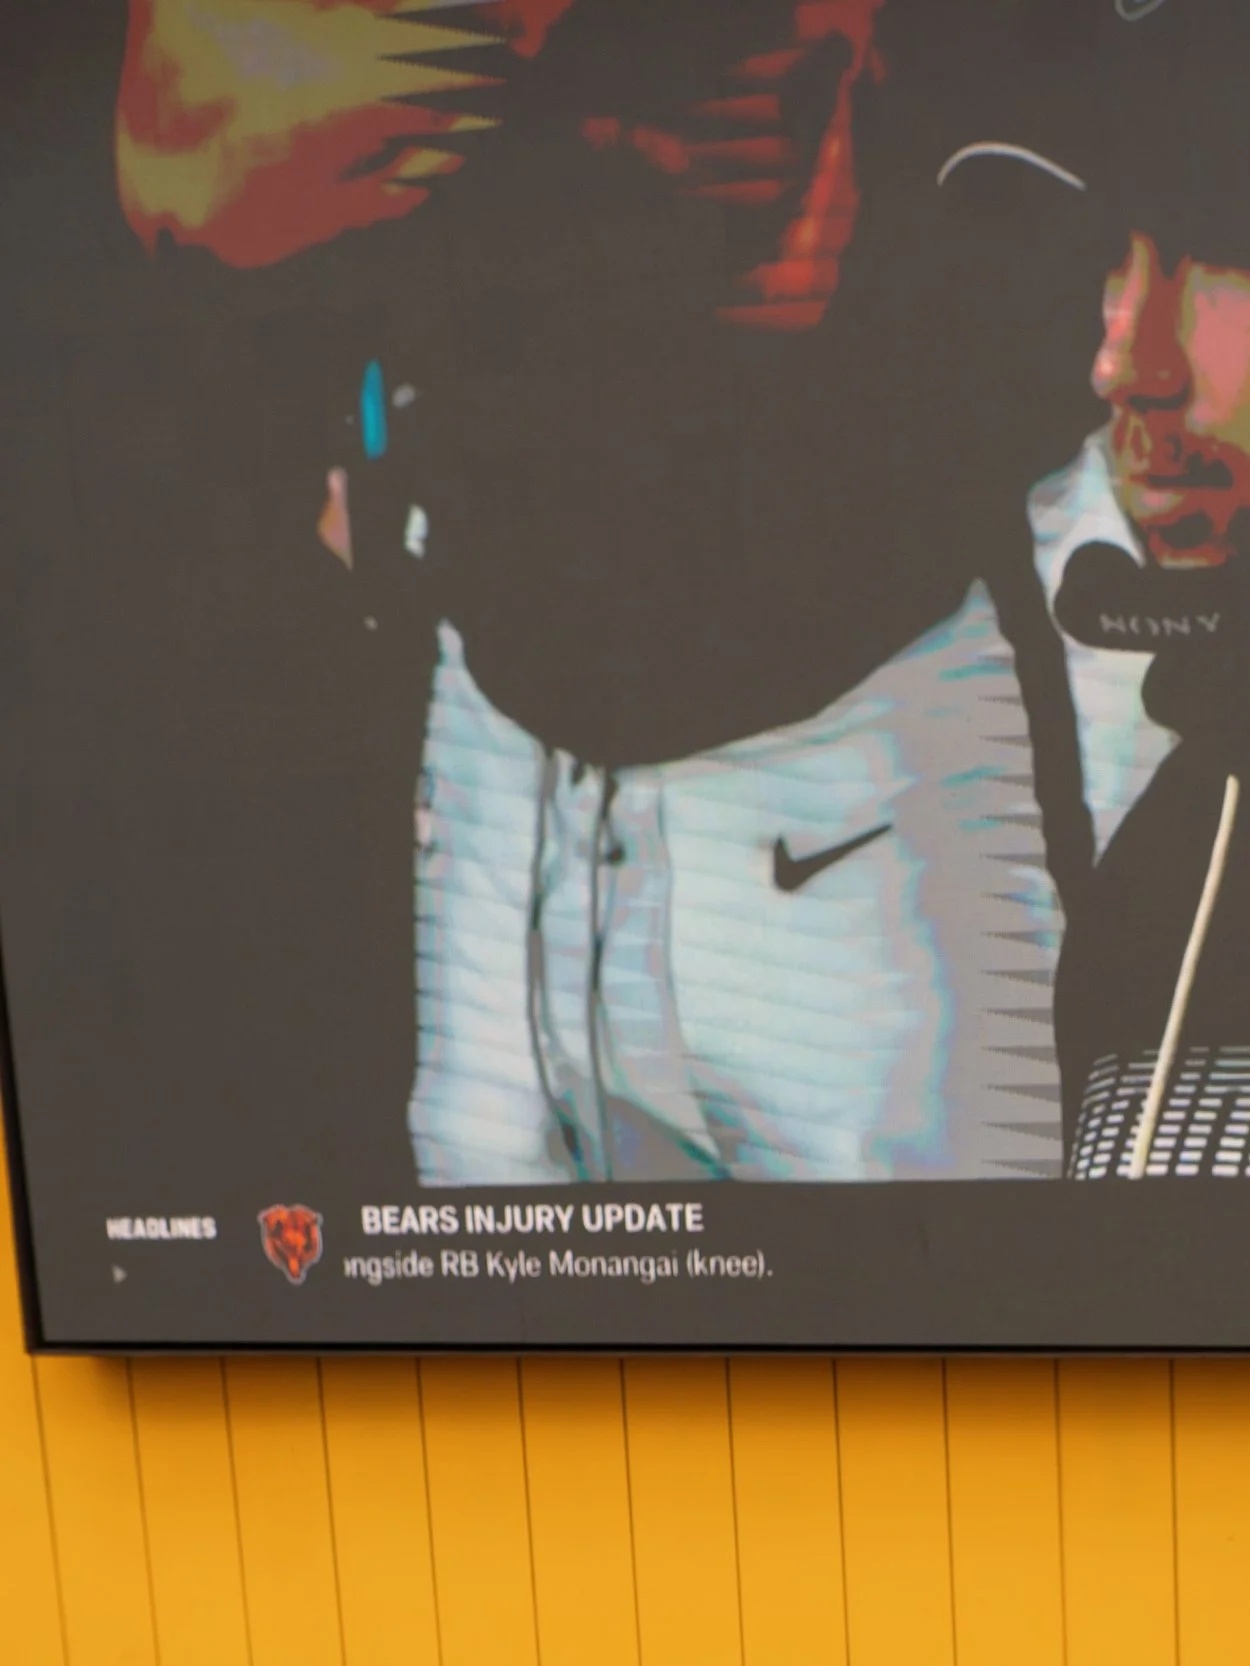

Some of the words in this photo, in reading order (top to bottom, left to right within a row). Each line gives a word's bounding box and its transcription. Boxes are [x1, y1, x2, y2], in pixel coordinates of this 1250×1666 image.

[105, 1215, 218, 1241] HEADLINES
[361, 1204, 459, 1235] BEARS
[464, 1203, 574, 1234] INJURY
[581, 1202, 705, 1233] UPDATE
[441, 1249, 479, 1278] RB
[486, 1249, 542, 1284] Kyle
[550, 1249, 679, 1285] Monangai
[685, 1248, 774, 1280] (knee).
